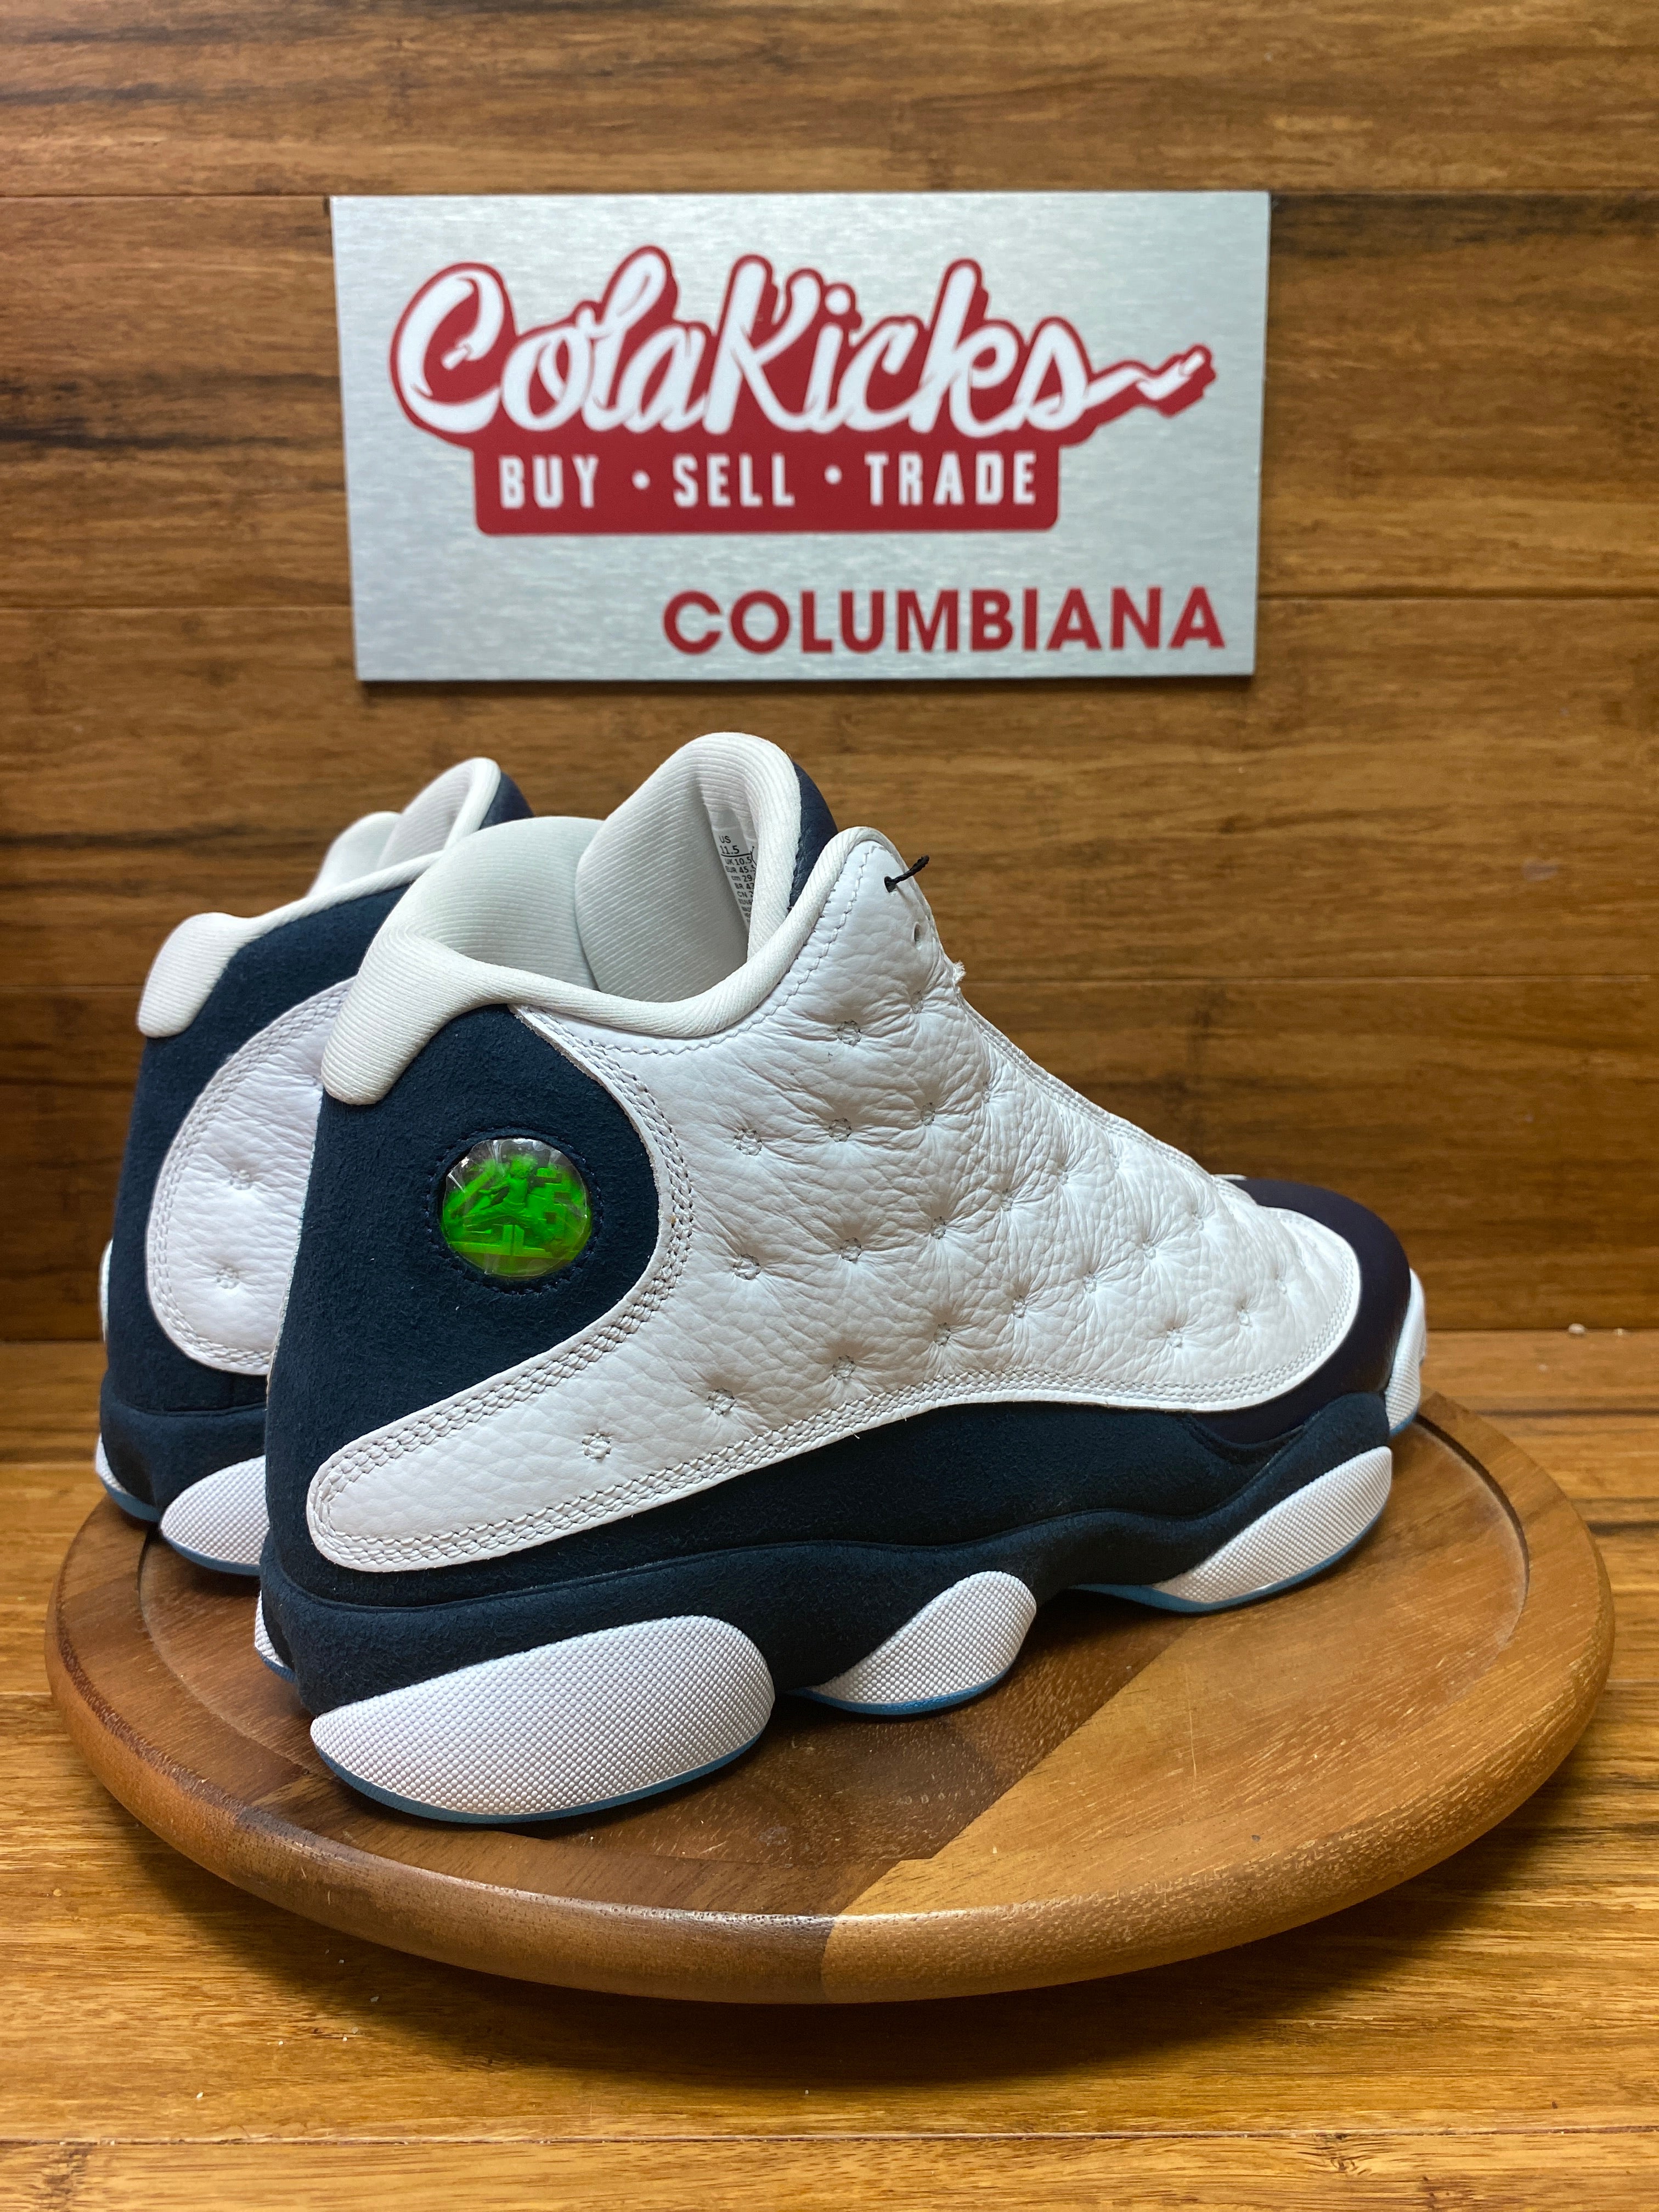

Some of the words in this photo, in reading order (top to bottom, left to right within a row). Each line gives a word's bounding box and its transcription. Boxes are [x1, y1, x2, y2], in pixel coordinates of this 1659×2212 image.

[391, 246, 1215, 440] ColaKicks
[498, 454, 599, 509] BUY
[672, 453, 796, 508] SELL
[864, 450, 1037, 506] TRADE
[662, 586, 1226, 656] COLUMBIANA
[720, 845, 740, 854] 11.5
[735, 856, 752, 865] 10.5
